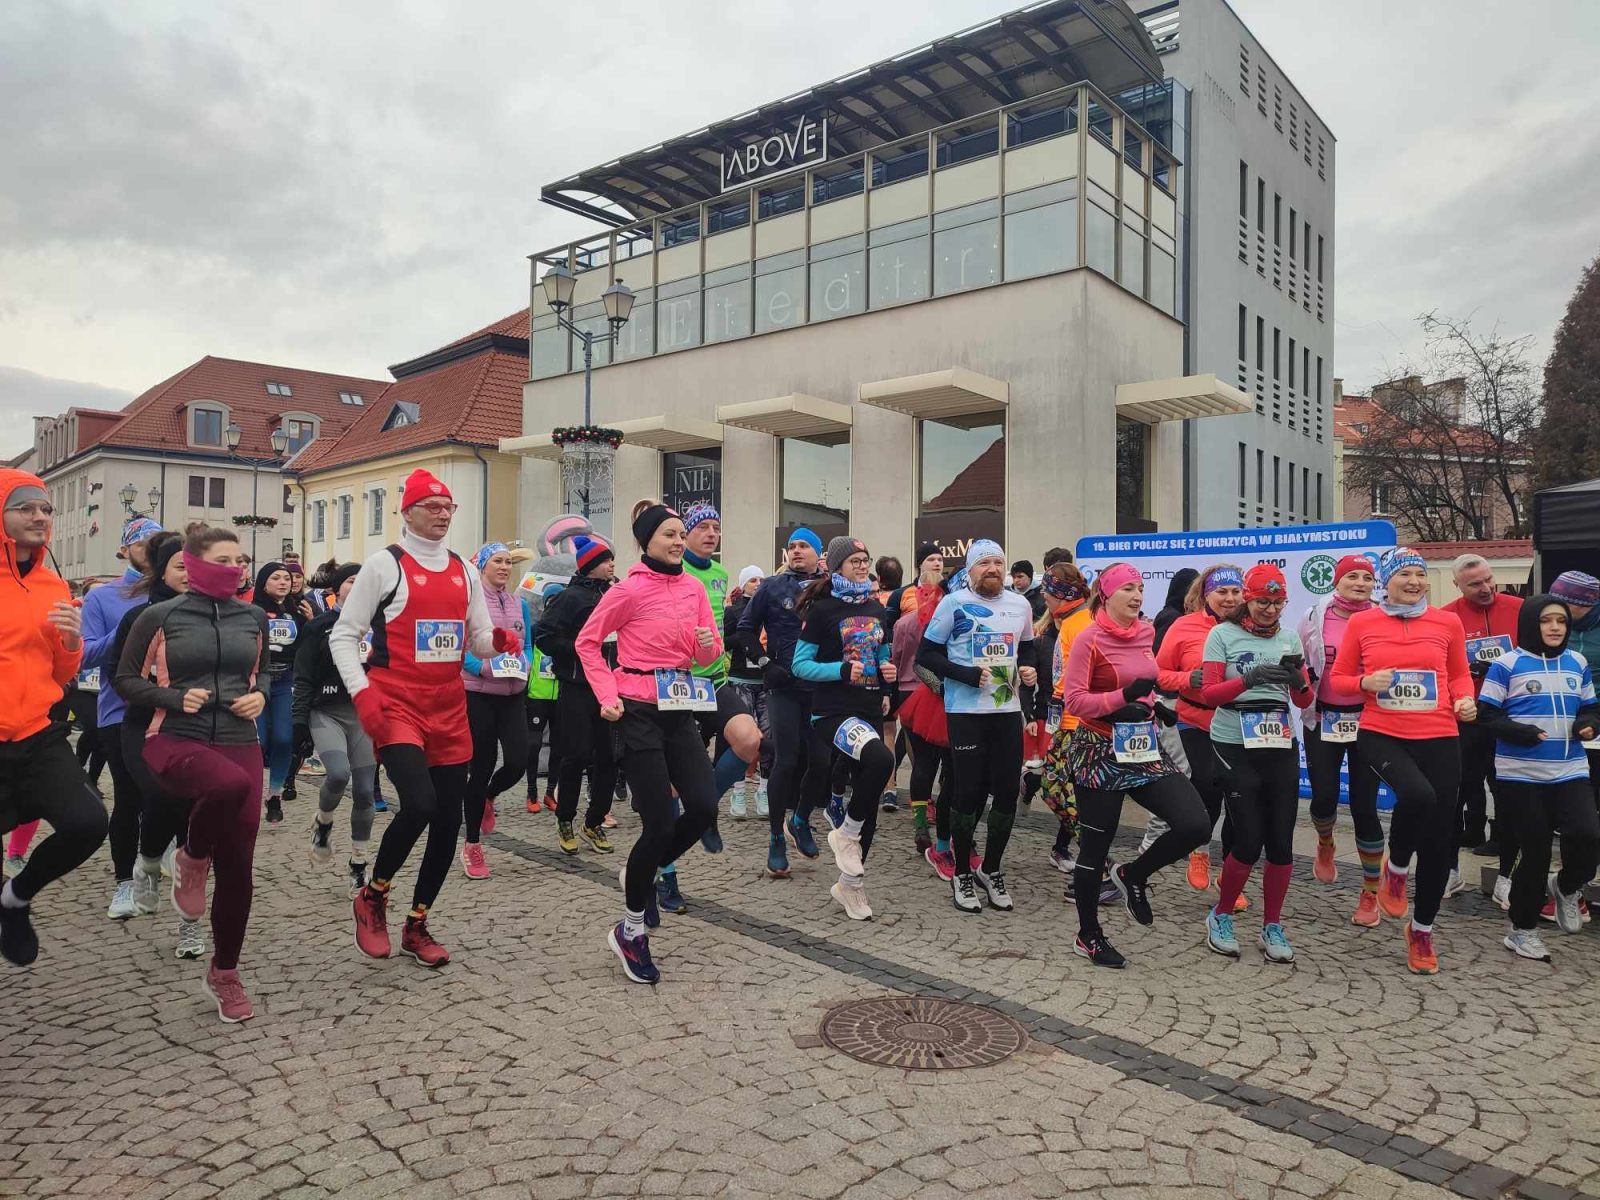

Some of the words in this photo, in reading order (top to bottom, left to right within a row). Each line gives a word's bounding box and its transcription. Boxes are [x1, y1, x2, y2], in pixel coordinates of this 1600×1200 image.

[726, 114, 817, 180] ABOVE
[678, 468, 711, 493] NIE
[1093, 542, 1107, 551] 19.
[1108, 541, 1131, 551] BIEG
[1133, 540, 1168, 550] POLICZ
[1169, 539, 1187, 550] SIĘ
[1188, 538, 1195, 549] Z
[1197, 536, 1257, 548] CUKRZYCĄ
[1259, 535, 1272, 545] W
[1274, 528, 1367, 544] BIAŁYMSTOKU
[272, 628, 287, 637] 198
[435, 635, 454, 648] 051
[986, 644, 1005, 655] 005
[1479, 647, 1501, 660] 060
[503, 659, 520, 669] 035
[673, 683, 688, 697] 015
[1394, 685, 1421, 697] 063
[847, 726, 867, 741] 079
[1259, 723, 1281, 735] 048
[1337, 721, 1357, 733] 155
[1129, 737, 1148, 750] 026
